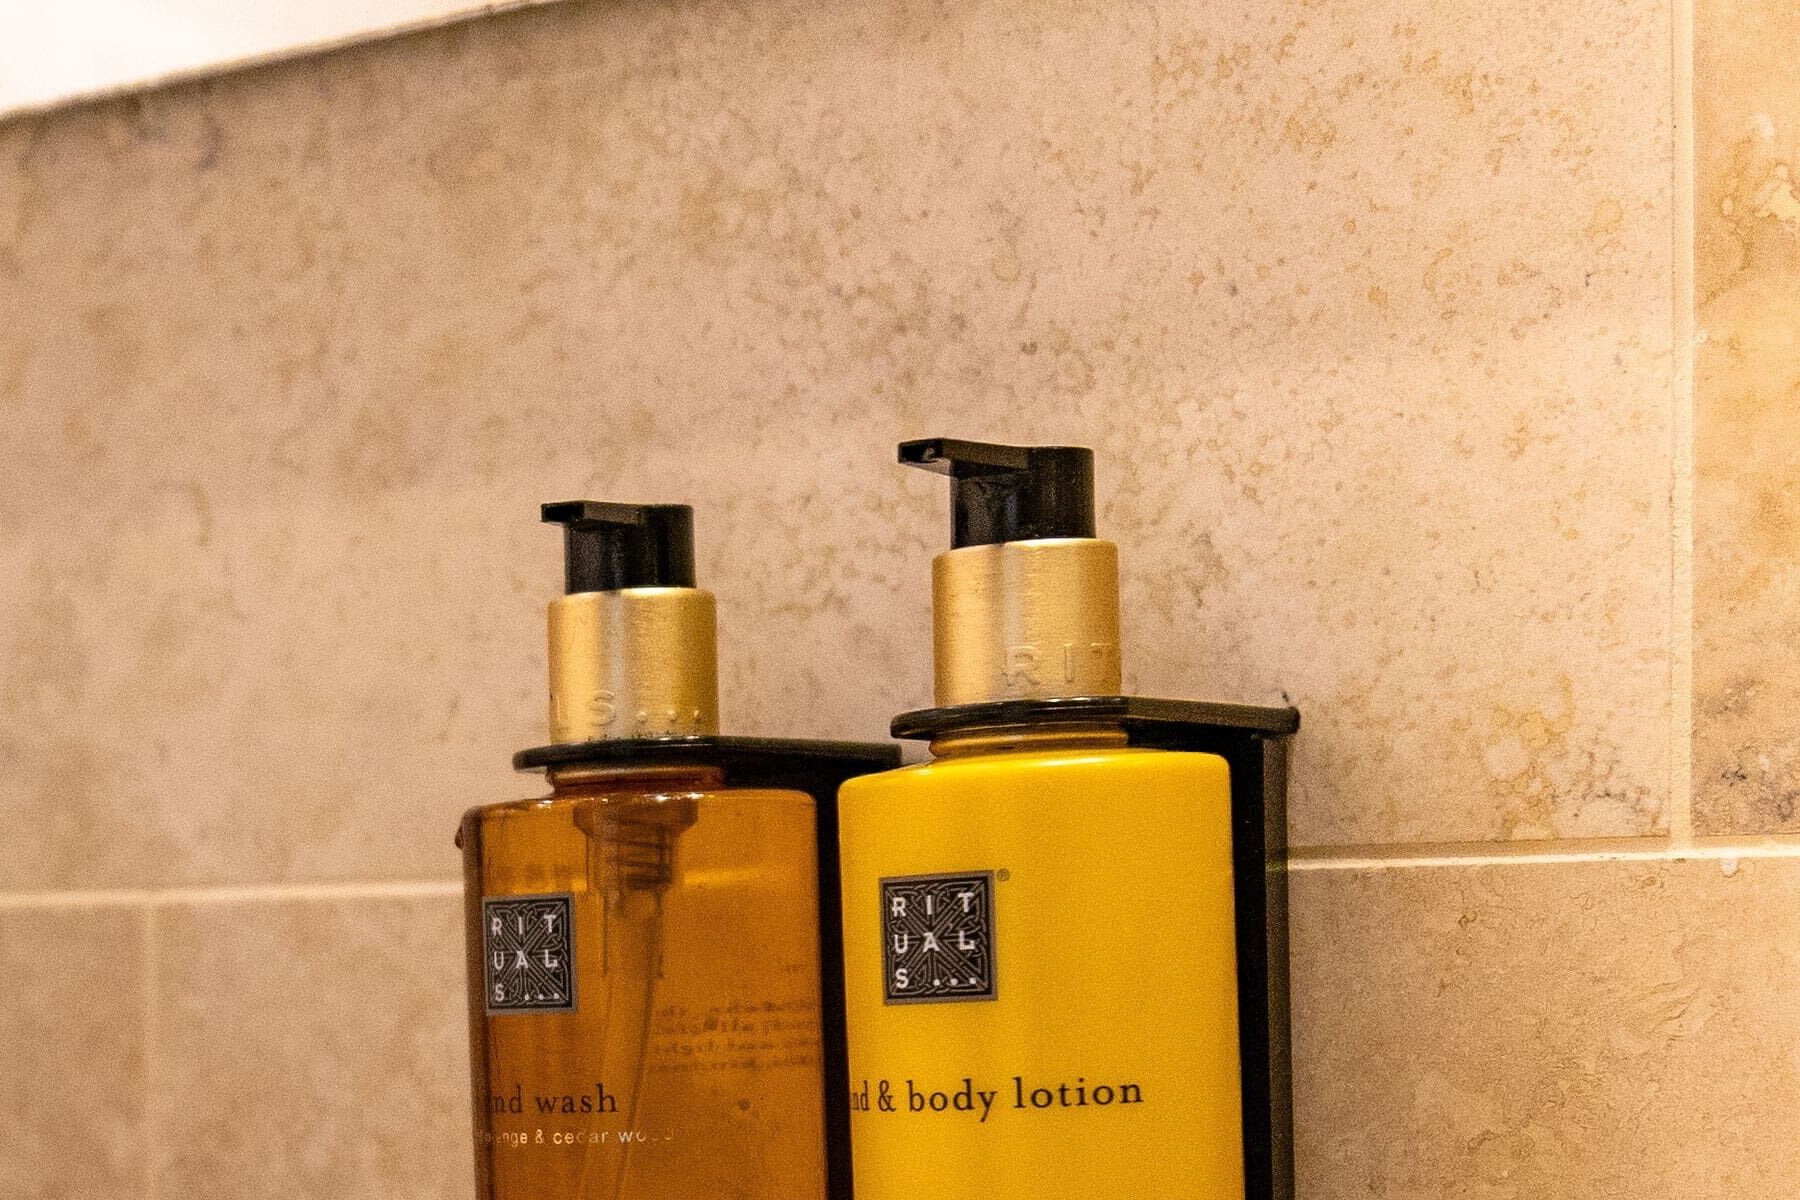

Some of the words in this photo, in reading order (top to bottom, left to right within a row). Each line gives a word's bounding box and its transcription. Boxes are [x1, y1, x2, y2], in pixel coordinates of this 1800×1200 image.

[891, 892, 974, 917] RIT
[491, 914, 557, 936] RIT
[894, 930, 975, 954] UAL
[494, 949, 558, 970] UAL
[535, 1083, 619, 1113] wash
[878, 1080, 897, 1112] &
[906, 1078, 998, 1122] body
[1013, 1076, 1144, 1109] lotion
[535, 1129, 545, 1144] &
